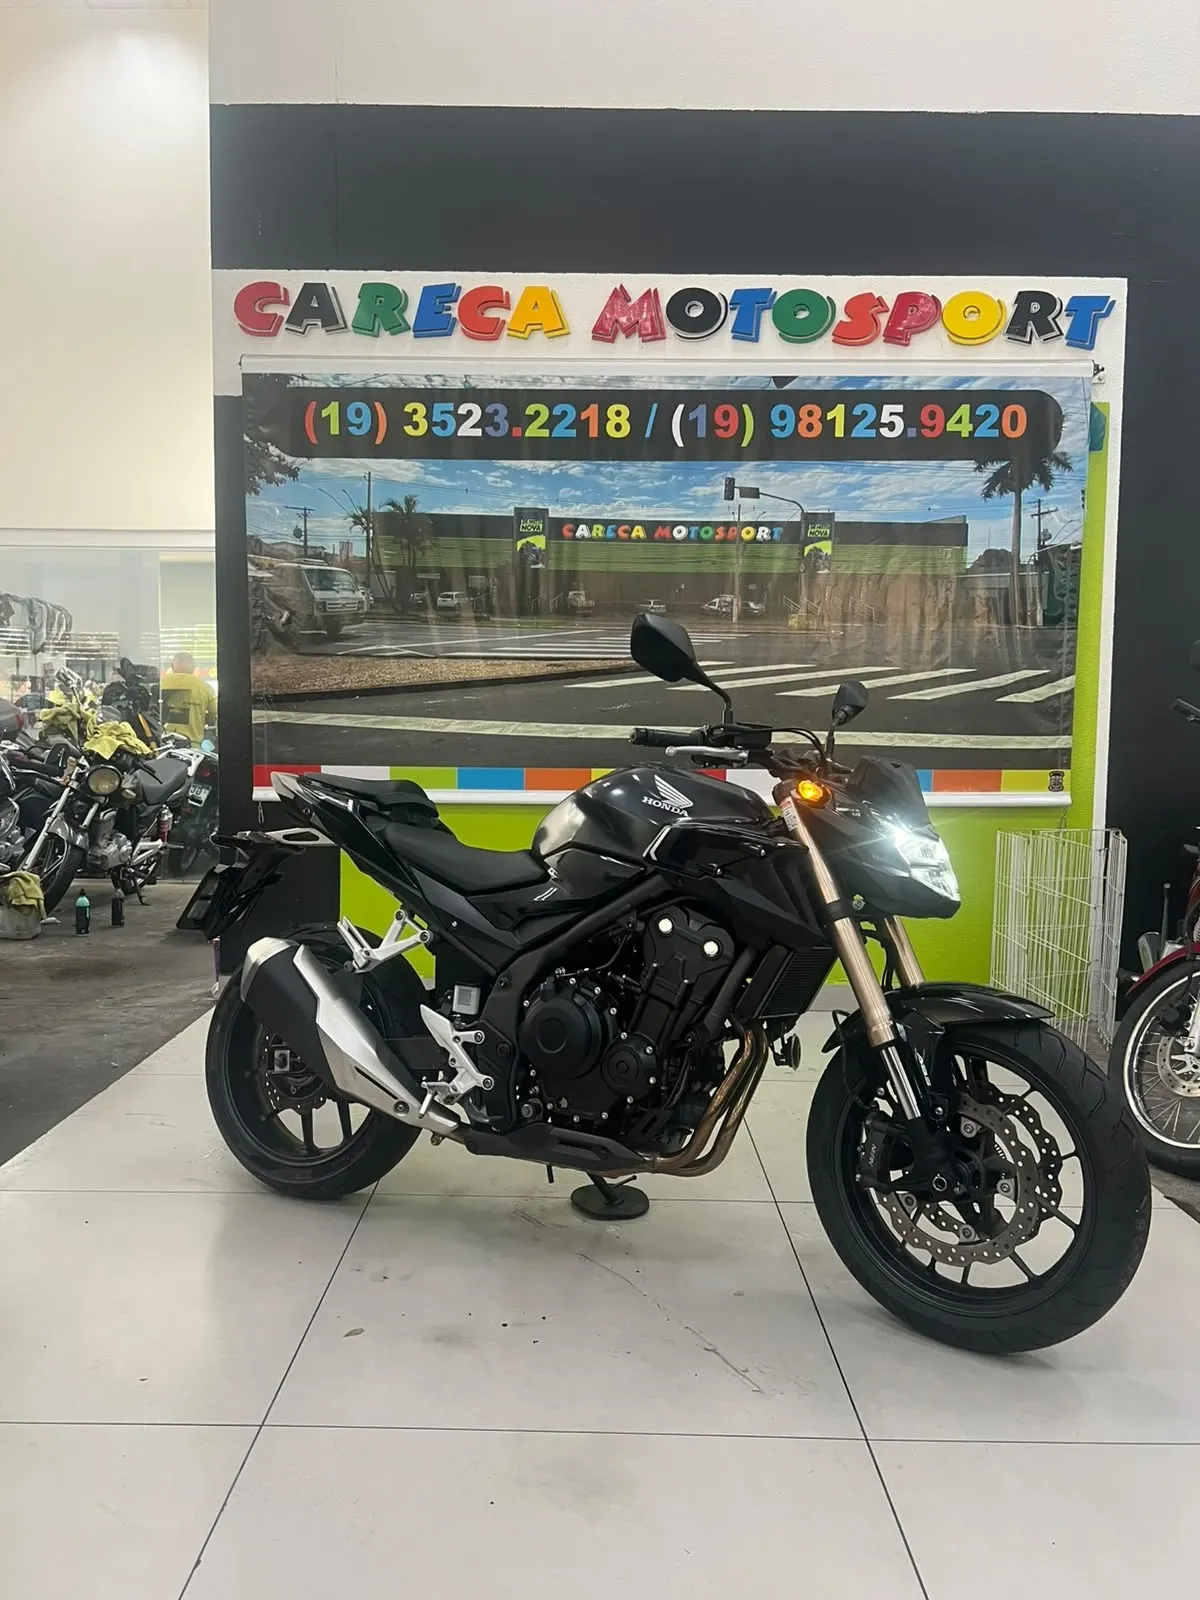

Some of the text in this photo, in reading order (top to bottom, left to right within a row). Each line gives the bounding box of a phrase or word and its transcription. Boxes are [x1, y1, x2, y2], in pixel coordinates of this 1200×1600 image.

[233, 280, 1116, 351] CARECA MOTOSPORT
[304, 401, 388, 445] (19)
[403, 402, 632, 439] 3523.2218
[671, 403, 755, 447] (19)
[770, 403, 1028, 439] 98125.9420
[562, 523, 784, 542] CARECA MOTOSPORT
[641, 796, 689, 817] HONDA
